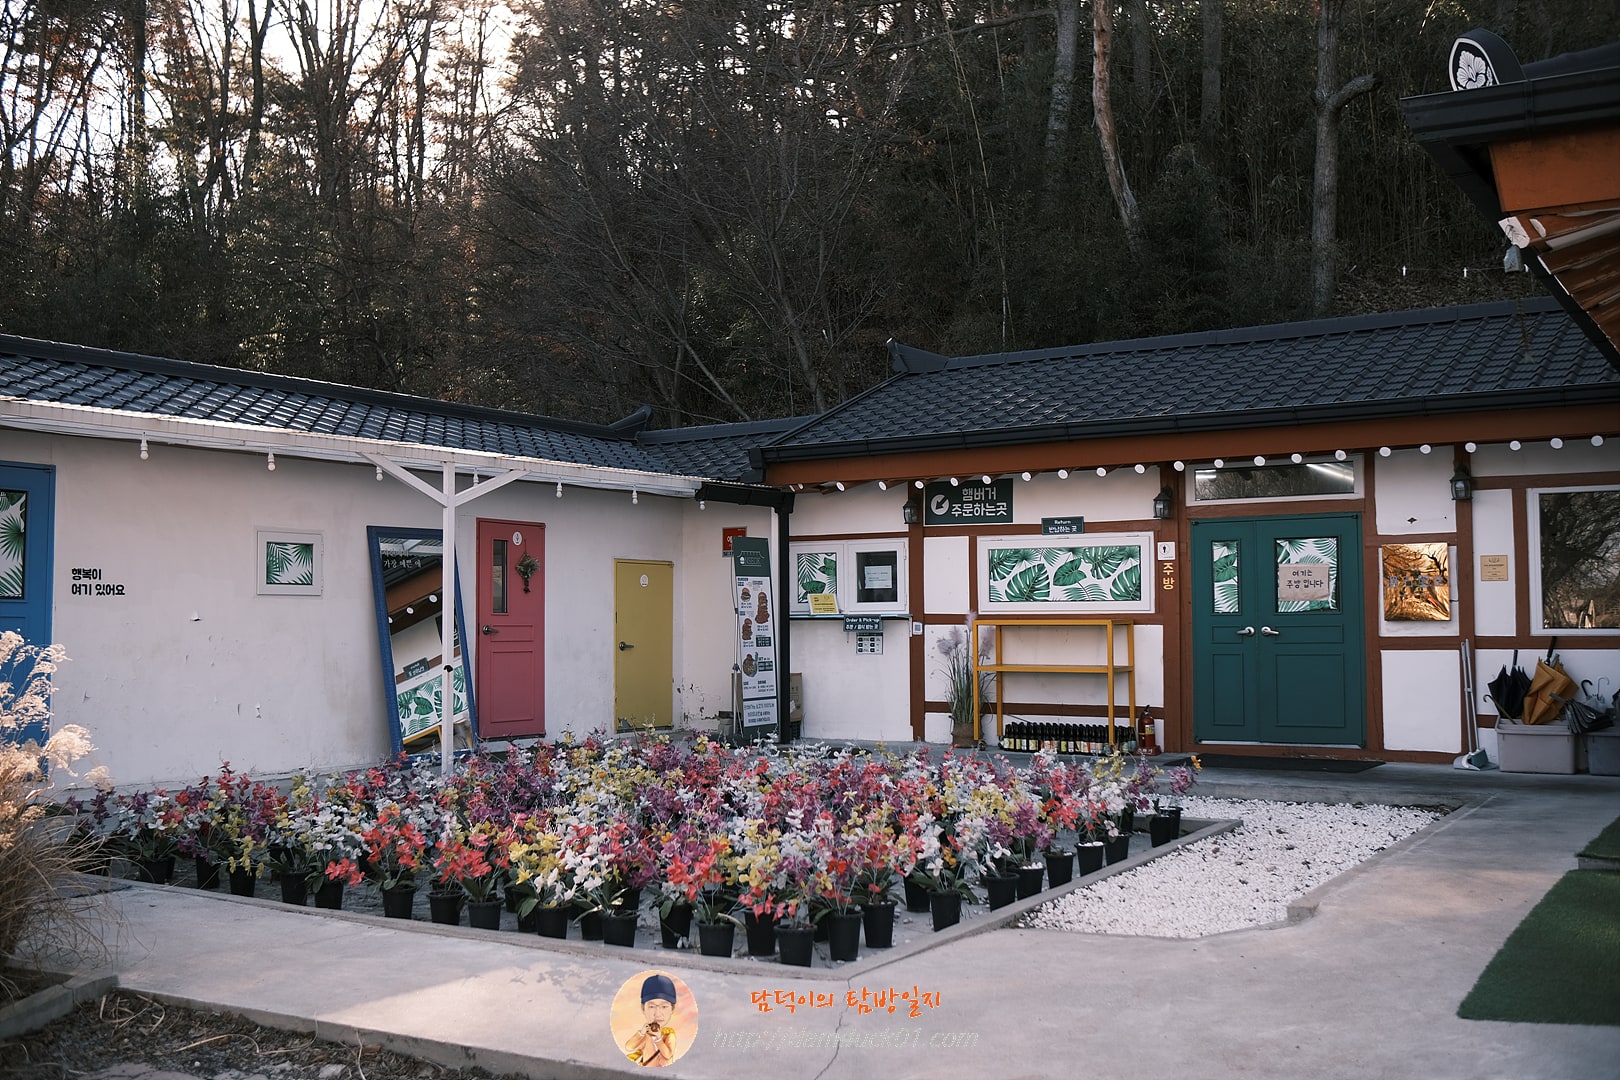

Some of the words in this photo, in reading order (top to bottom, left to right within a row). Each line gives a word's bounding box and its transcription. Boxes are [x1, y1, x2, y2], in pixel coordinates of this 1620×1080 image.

[962, 487, 997, 501] 햄버거
[951, 502, 1008, 517] 주문하는곳
[1048, 525, 1071, 533] 반납하는
[1071, 525, 1077, 533] 곳
[71, 568, 102, 581] 행복이
[1162, 562, 1176, 590] 주방
[1292, 569, 1313, 577] 여기는
[71, 583, 92, 596] 여기
[95, 583, 126, 596] 있어요
[1285, 580, 1301, 589] 주방
[1303, 579, 1324, 588] 입니다
